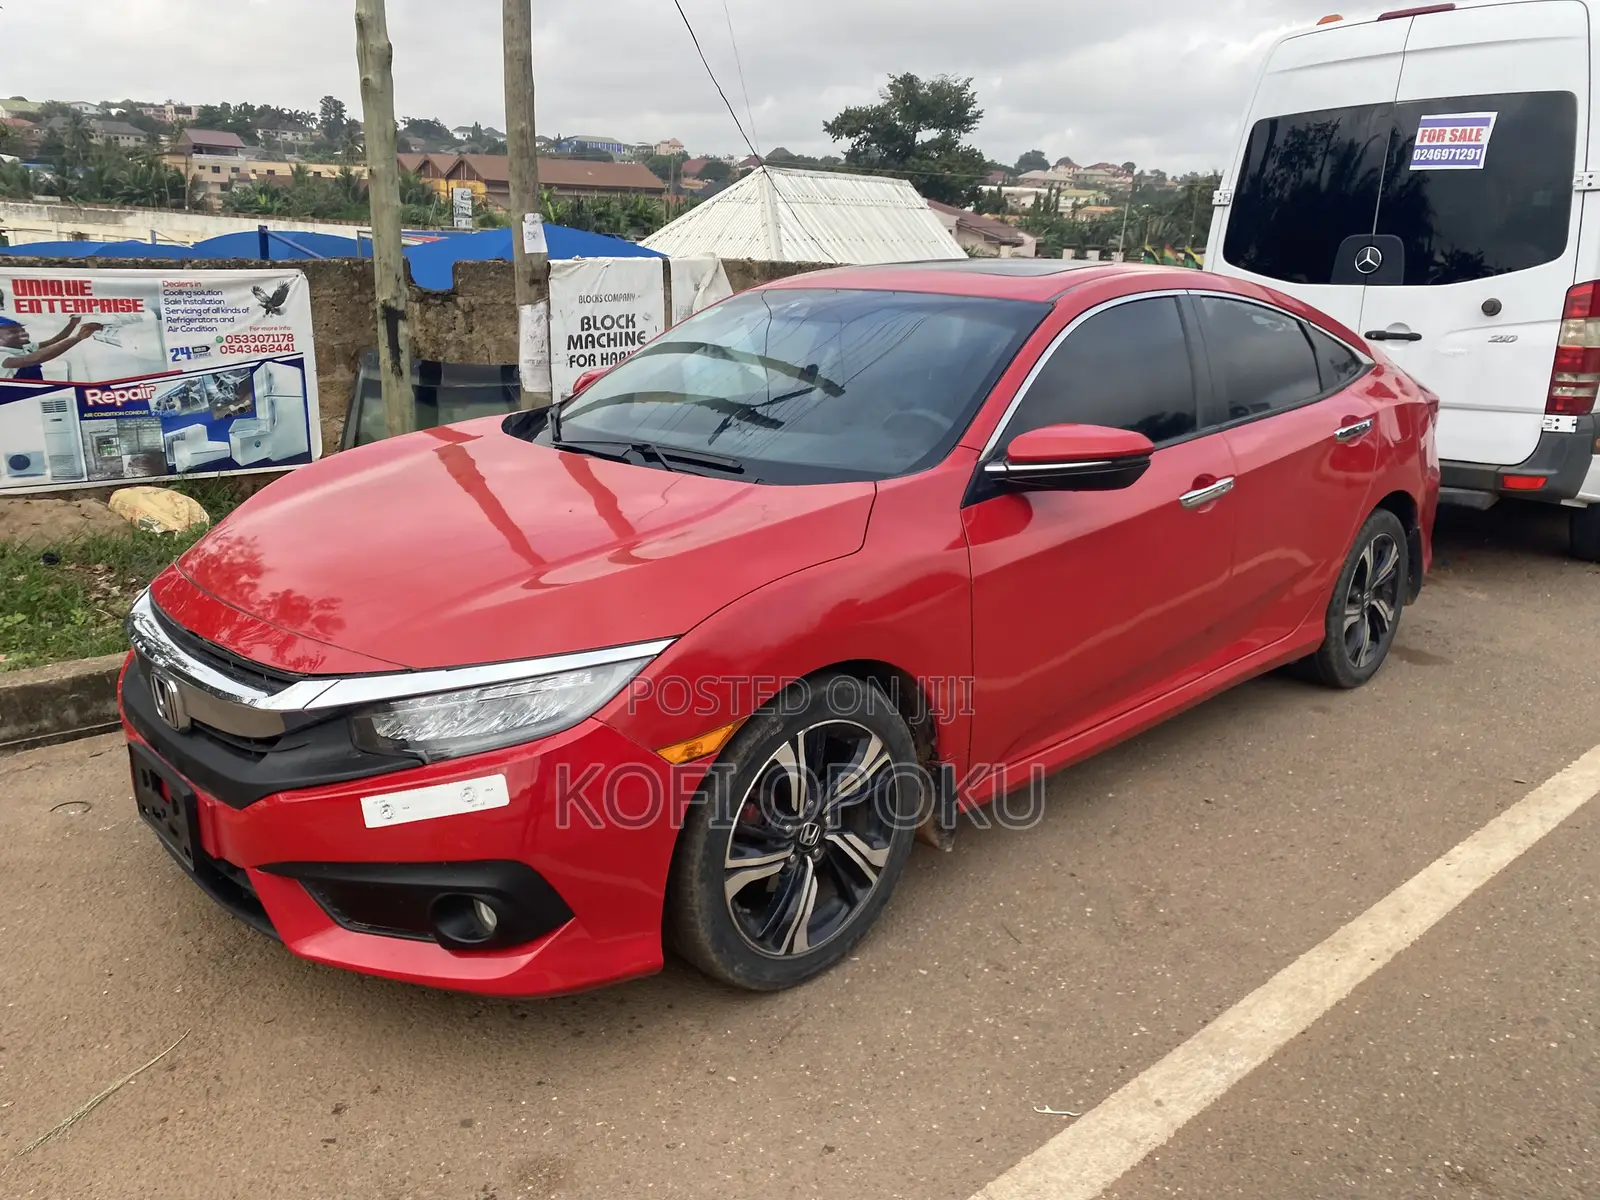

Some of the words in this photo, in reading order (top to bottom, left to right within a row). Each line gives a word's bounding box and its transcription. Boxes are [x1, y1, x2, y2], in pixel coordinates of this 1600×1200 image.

[1419, 128, 1446, 143] FOR
[1449, 128, 1483, 142] SALE
[1413, 148, 1481, 160] 0246971291
[11, 279, 93, 297] UNIQUE
[162, 280, 194, 288] Dealers
[163, 289, 193, 298] Cooling
[578, 294, 603, 304] BLOCKS
[604, 292, 636, 303] COMPANY
[14, 298, 145, 314] ENTERPRISE
[165, 307, 202, 316] Servicing
[241, 306, 250, 314] of
[166, 316, 219, 325] Refrigerators
[580, 313, 636, 332] BLOCK
[167, 325, 179, 333] Air
[180, 325, 217, 333] Condition
[225, 333, 294, 344] 0533071178
[567, 330, 646, 350] MACHINE
[170, 346, 192, 362] 24
[219, 343, 295, 354] 0543462441
[569, 353, 597, 368] FOR
[84, 383, 156, 407] Repair
